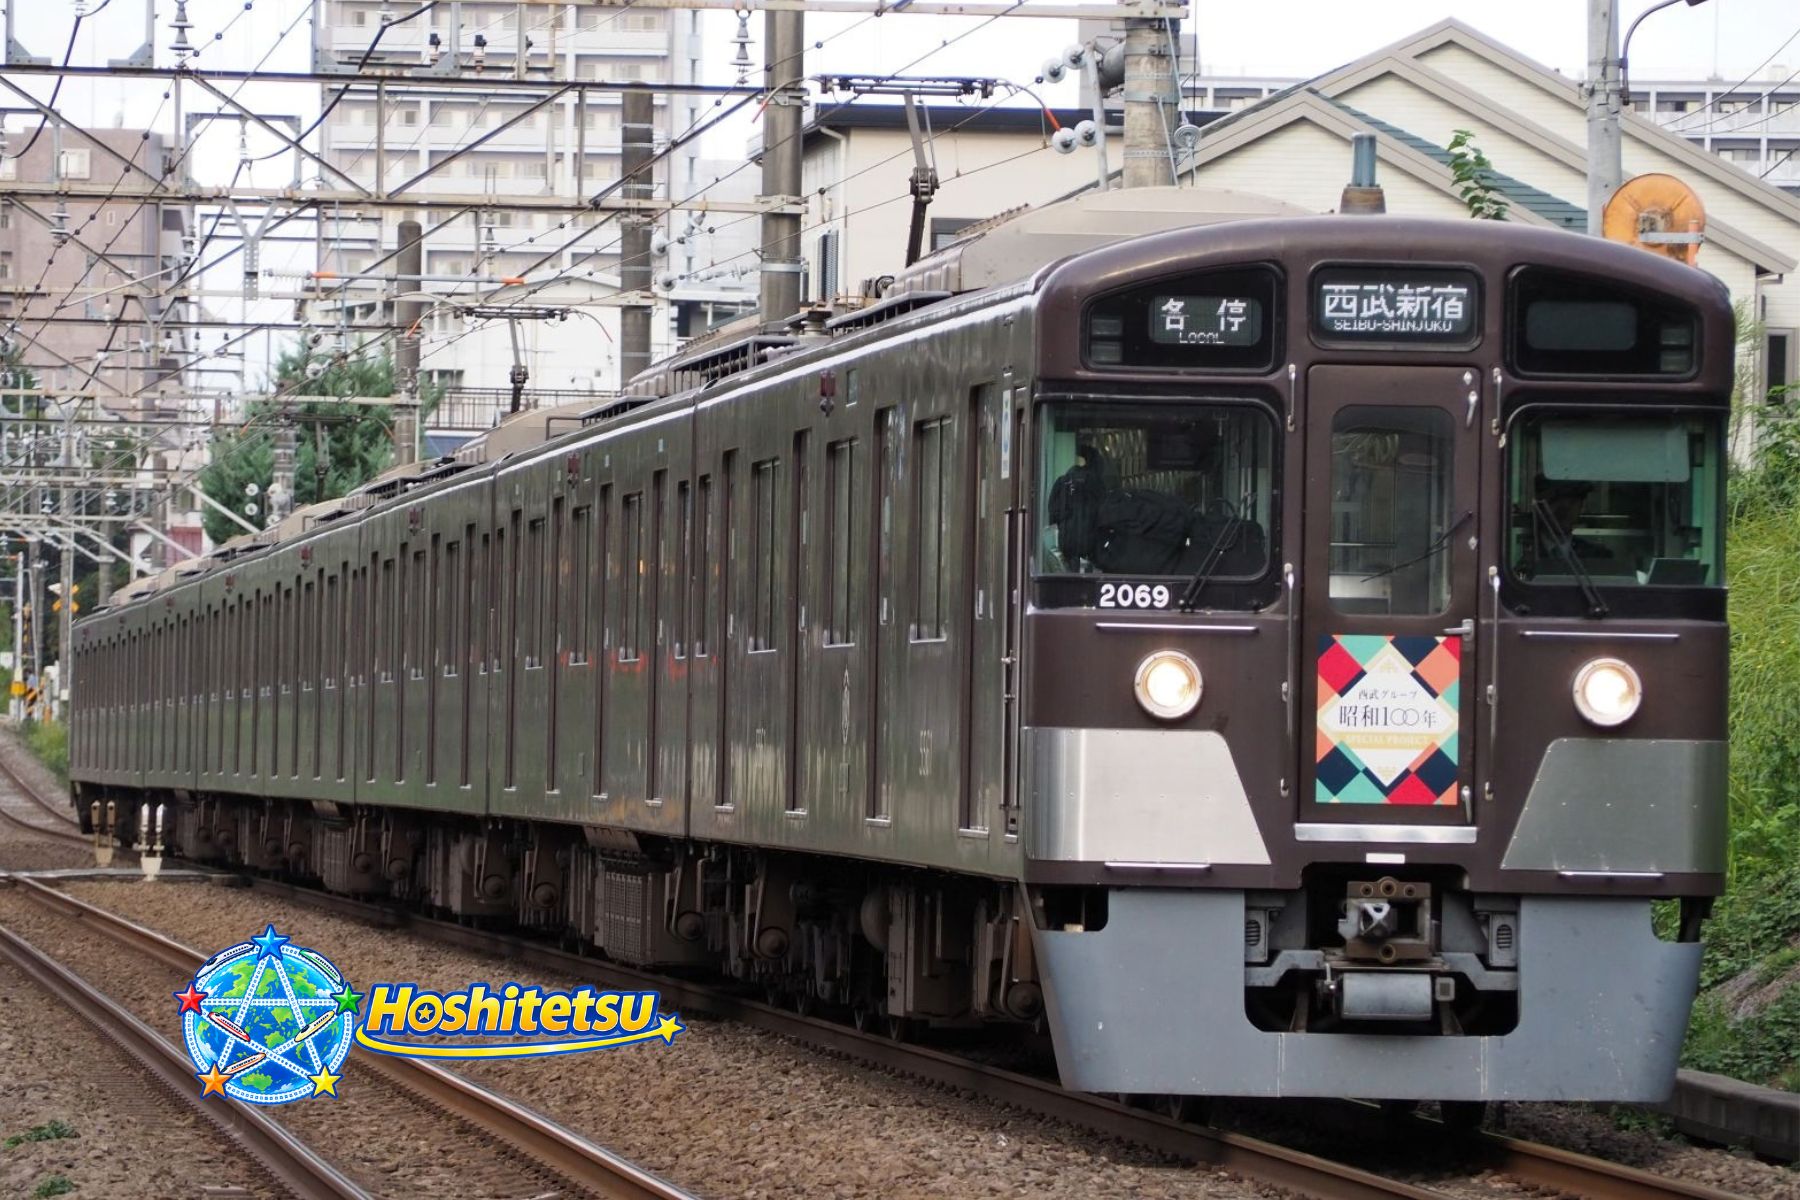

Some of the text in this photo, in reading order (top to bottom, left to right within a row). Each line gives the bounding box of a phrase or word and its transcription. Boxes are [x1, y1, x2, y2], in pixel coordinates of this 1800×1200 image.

[1322, 283, 1468, 318] 西武新宿
[1161, 298, 1247, 331] 各停
[1334, 319, 1453, 332] SEIBU-SHINJUKU
[1179, 331, 1225, 344] LOCAL
[1100, 583, 1170, 608] 2069
[1358, 688, 1418, 700] 西武グループ
